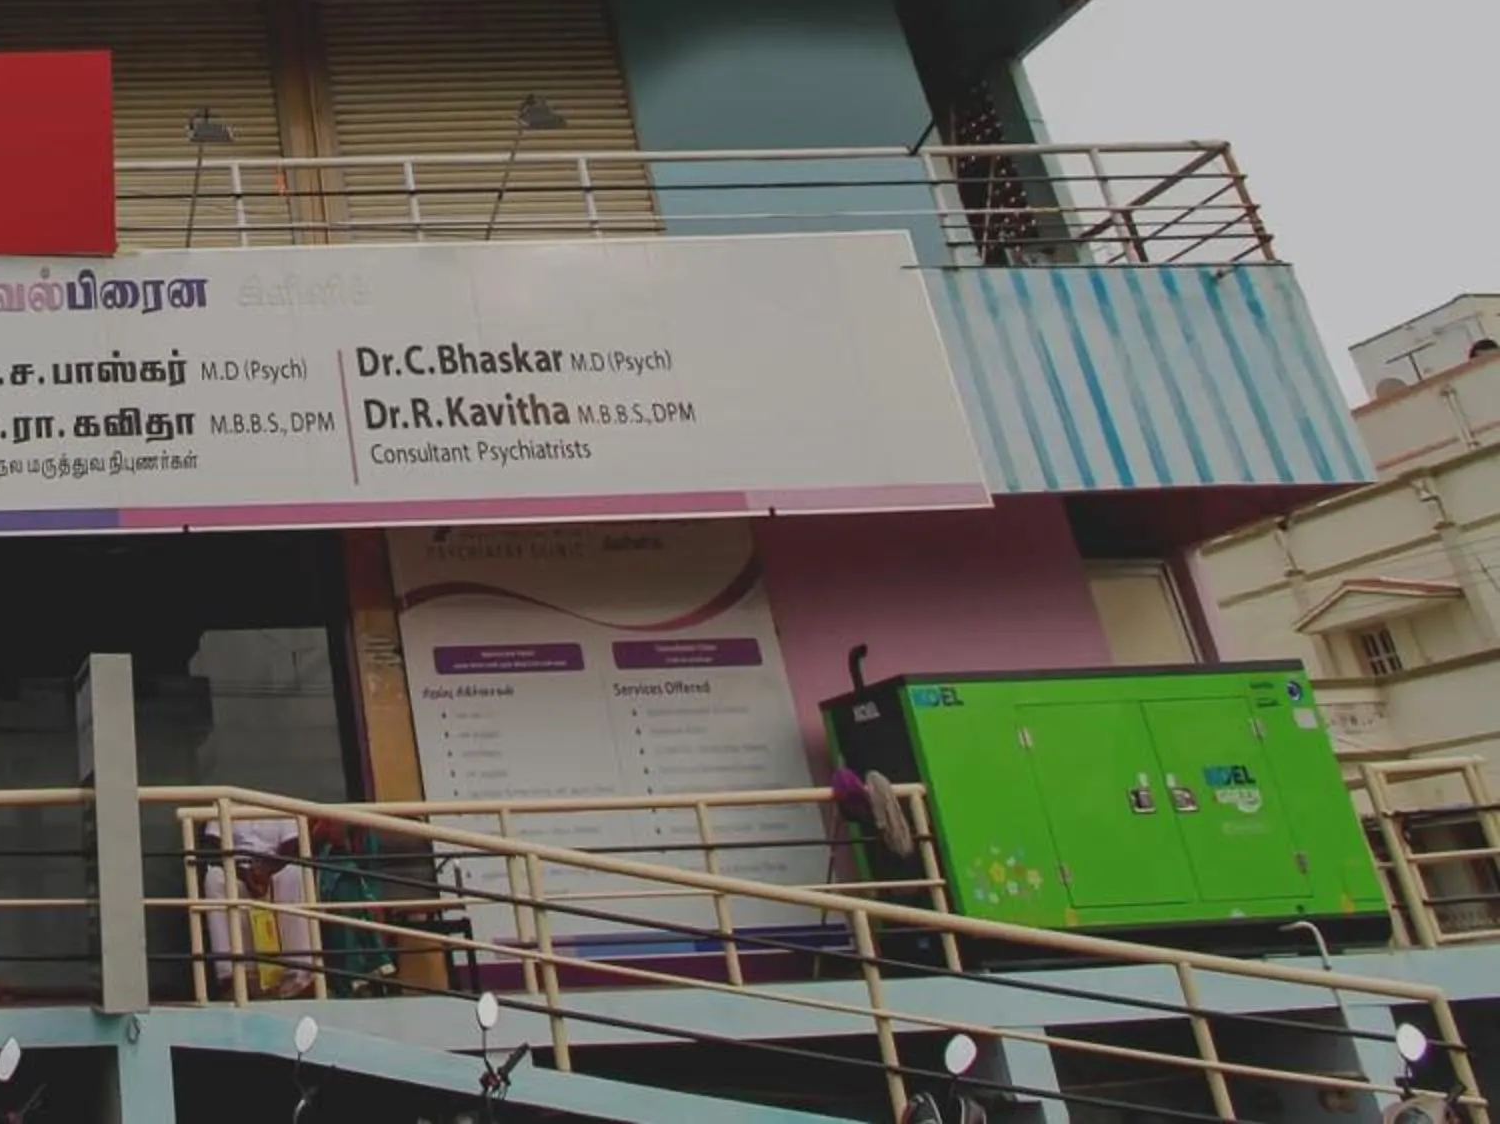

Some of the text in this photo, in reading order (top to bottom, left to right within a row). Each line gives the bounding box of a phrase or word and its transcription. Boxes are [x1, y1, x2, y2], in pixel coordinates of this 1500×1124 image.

[371, 438, 592, 469] Consultant Psychiatrists
[613, 680, 711, 697] Services Offered
